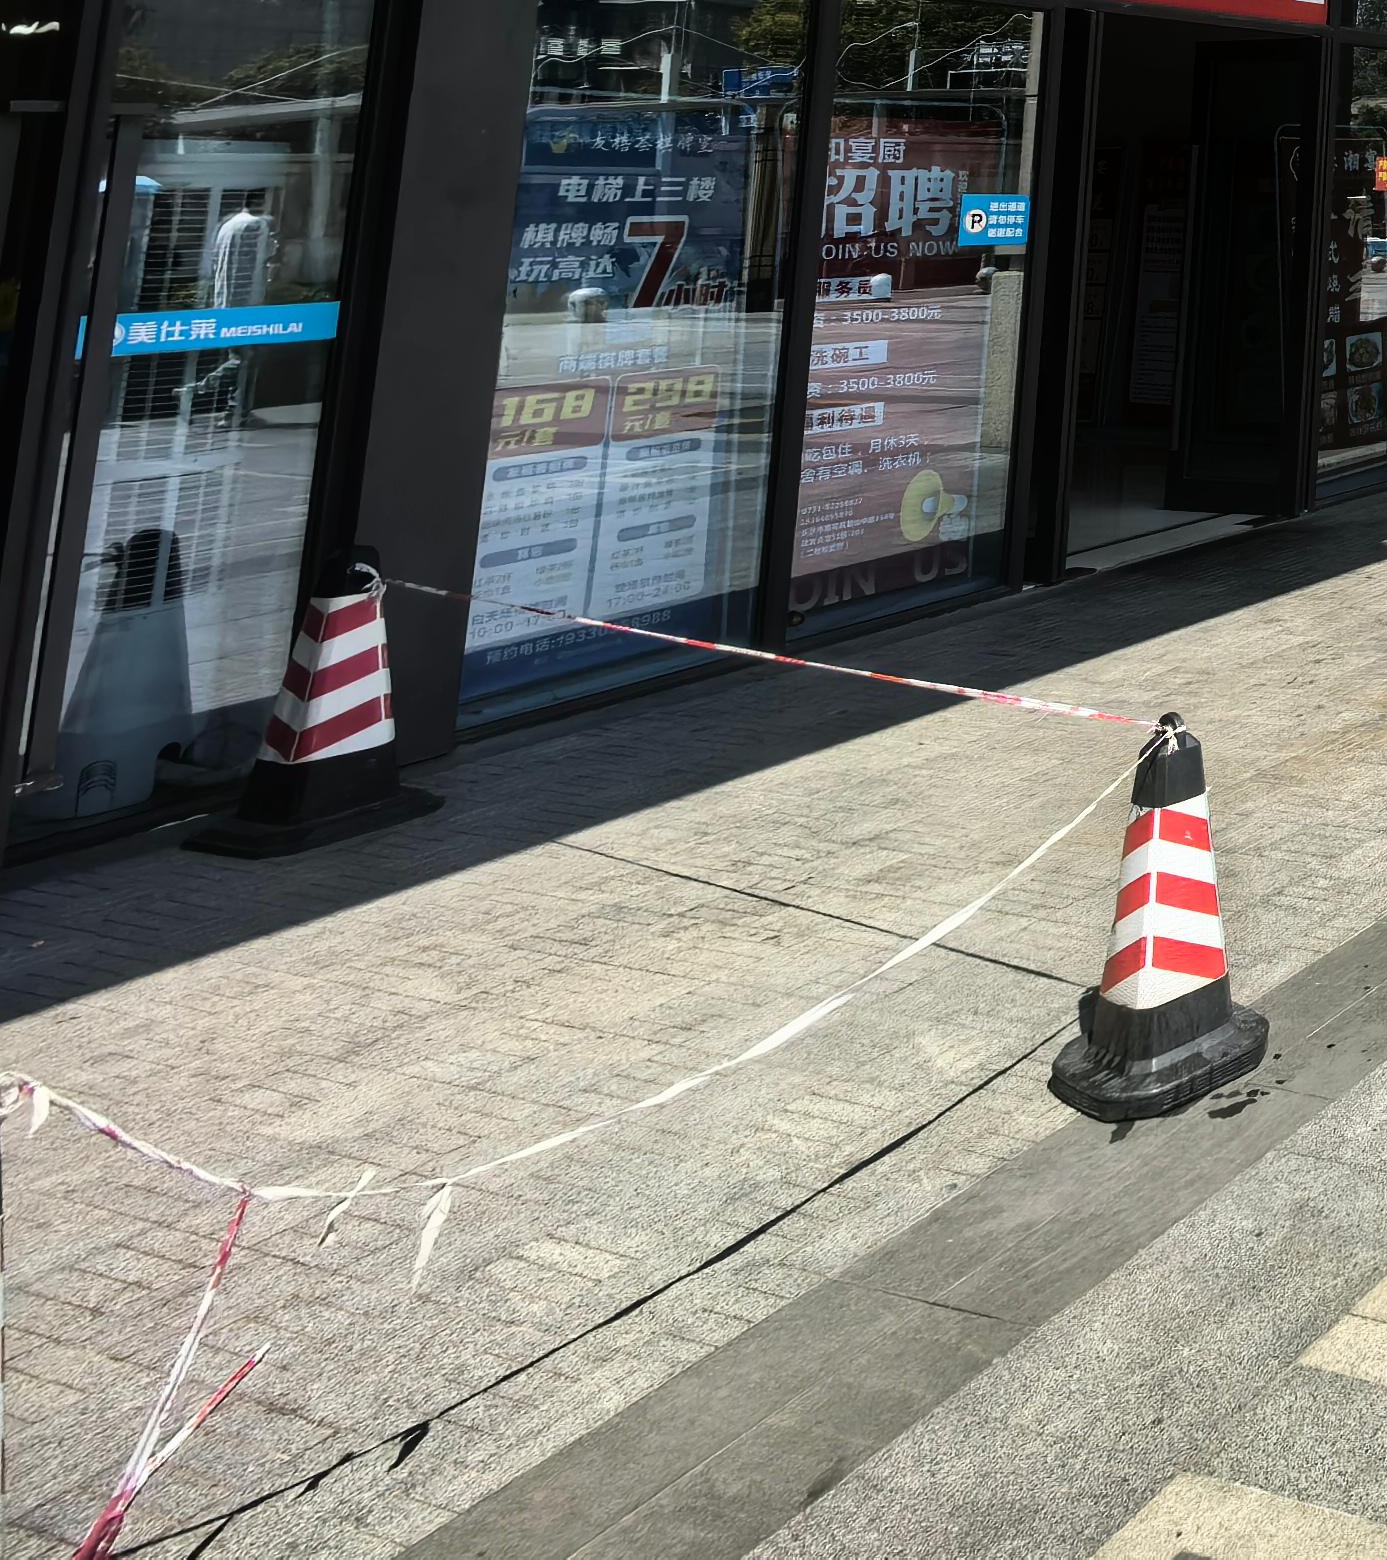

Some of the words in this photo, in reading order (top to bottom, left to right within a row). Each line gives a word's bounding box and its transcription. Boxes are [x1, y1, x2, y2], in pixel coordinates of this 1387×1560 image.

[557, 175, 717, 204] 电梯上三楼
[822, 166, 956, 239] 招聘
[520, 221, 620, 249] 棋牌畅
[624, 215, 689, 309] 7
[821, 243, 860, 261] OIN
[870, 241, 899, 258] US
[512, 255, 617, 283] 玩高达
[127, 319, 217, 345] 美仕莱
[220, 321, 303, 338] MEISHILAI
[811, 345, 871, 366] 洗碗工
[500, 388, 596, 427] 168
[622, 374, 716, 413] 298
